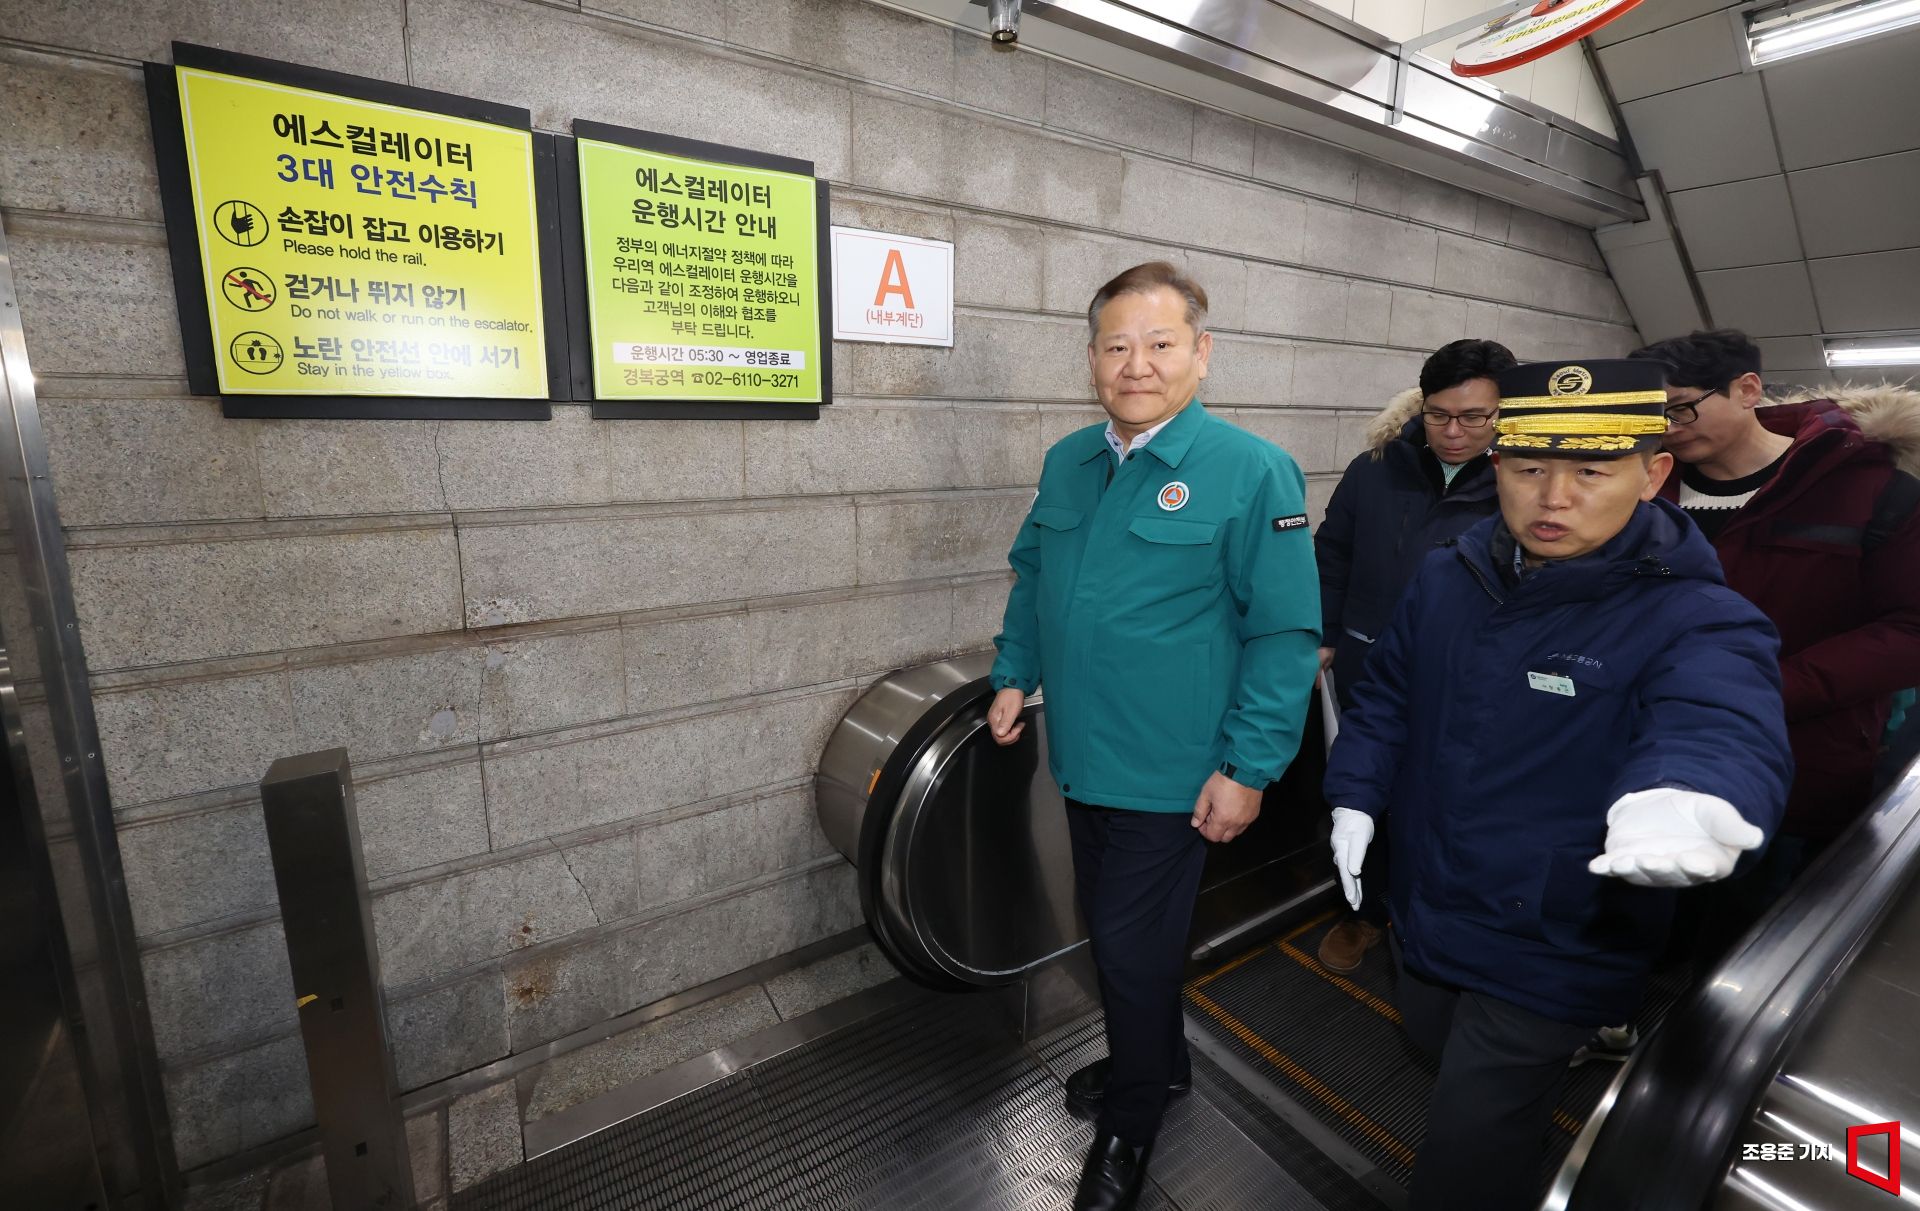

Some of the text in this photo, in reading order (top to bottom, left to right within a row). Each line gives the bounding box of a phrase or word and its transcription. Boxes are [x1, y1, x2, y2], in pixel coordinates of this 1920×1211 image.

[273, 113, 474, 171] 에스컬레이터
[277, 154, 477, 208] 3대 안전수칙
[635, 168, 771, 208] 에스컬레이터
[277, 206, 504, 255] 손잡이 잡고 이용하기
[632, 199, 777, 239] 운행시간 안내
[284, 240, 426, 266] Please hold the rail.
[616, 237, 794, 268] 정부의 에너지절약 정책에 따라
[613, 257, 797, 288] 우리역 에스컬레이터 운행시간을
[874, 249, 915, 309] A
[284, 273, 466, 310] 걷거나 뛰지 않기
[612, 278, 800, 306] 다음과 같이 조정하여 운행하오니
[291, 305, 533, 333] Do not walk or run on the escalator.
[643, 301, 777, 323] 고객님의 이해와 협조를
[866, 310, 923, 329] (내부계단)
[671, 322, 754, 339] 부탁 드립니다.
[294, 336, 520, 369] 노란 안전선 안에 서기
[631, 345, 684, 362] 운행시간
[688, 348, 723, 363] 05:30
[745, 350, 791, 366] 영업종료
[298, 363, 454, 380] Stay in the yellow box.
[623, 368, 684, 386] 경복궁역
